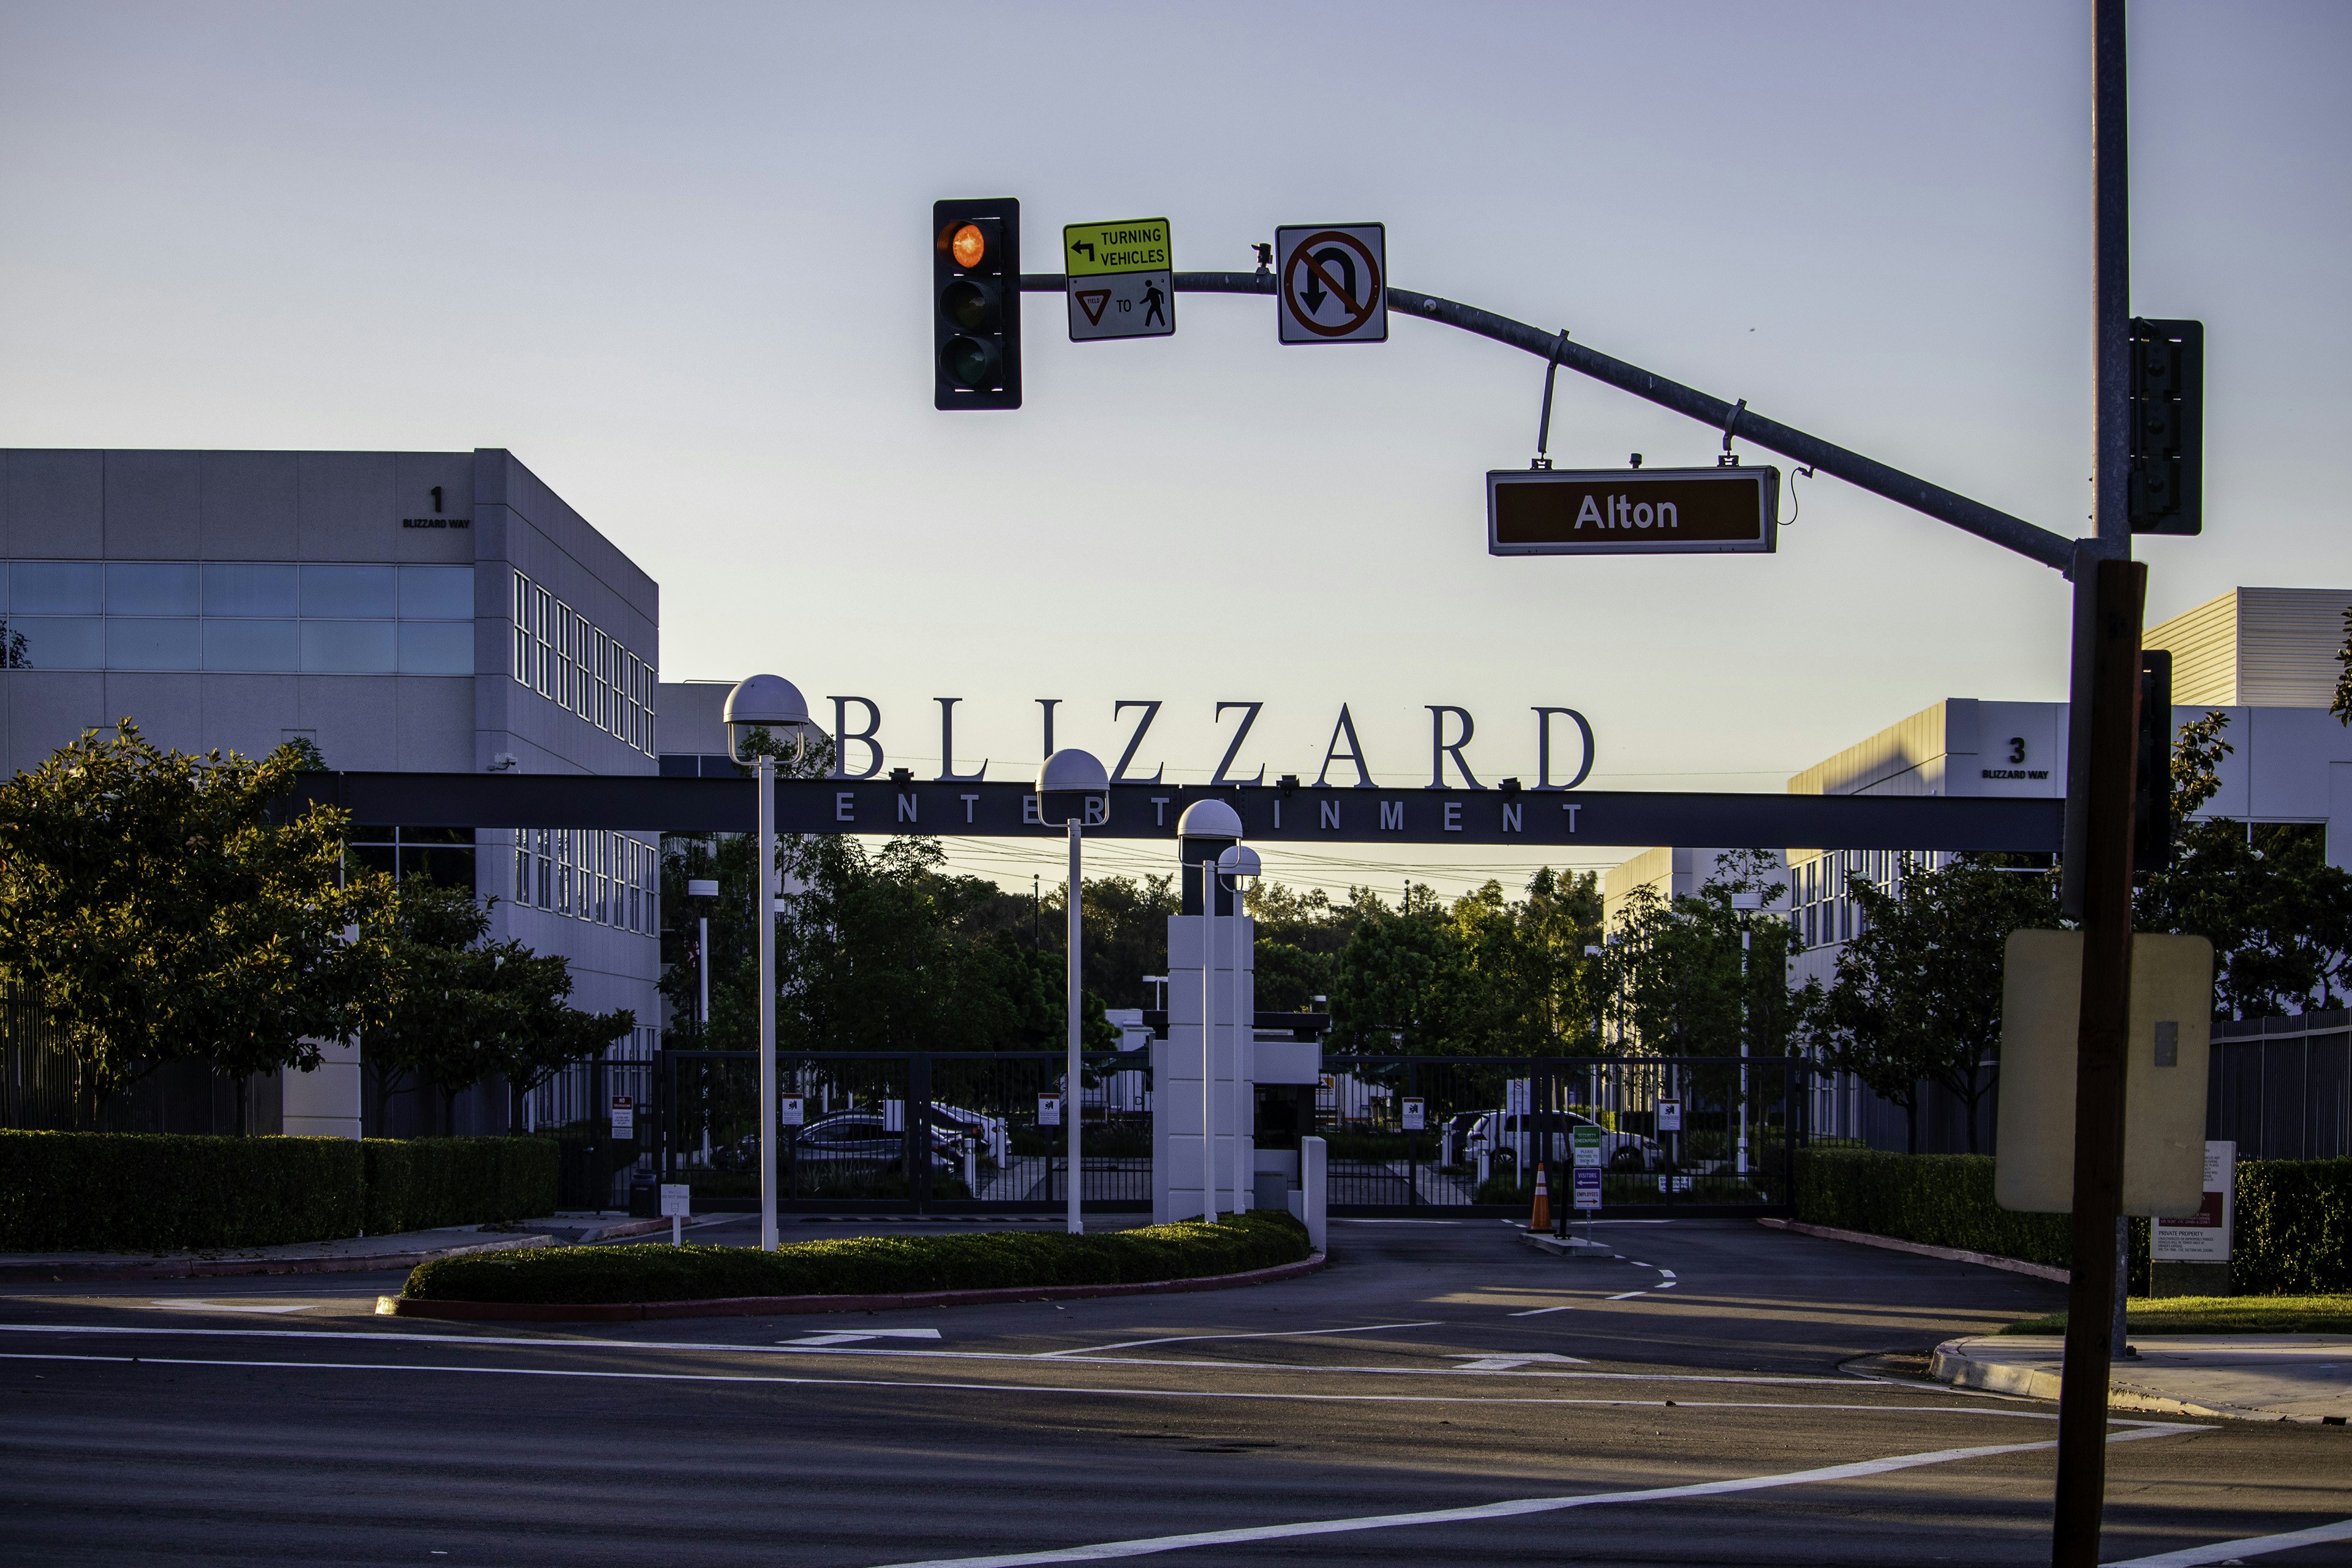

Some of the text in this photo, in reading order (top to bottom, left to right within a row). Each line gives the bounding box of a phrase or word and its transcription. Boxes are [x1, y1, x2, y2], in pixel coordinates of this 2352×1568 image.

[1101, 228, 1161, 245] TURNING
[1101, 249, 1164, 266] VEHICLES
[1116, 300, 1132, 312] TO
[431, 486, 442, 513] 1
[1574, 494, 1678, 529] Alton
[403, 519, 470, 529] BLIZZARD WAY
[827, 696, 1595, 791] BLIZZARD
[2010, 737, 2026, 763] 3
[1983, 770, 2049, 779] BLIZZARD WAY
[836, 792, 1581, 833] ENTERTINMENT
